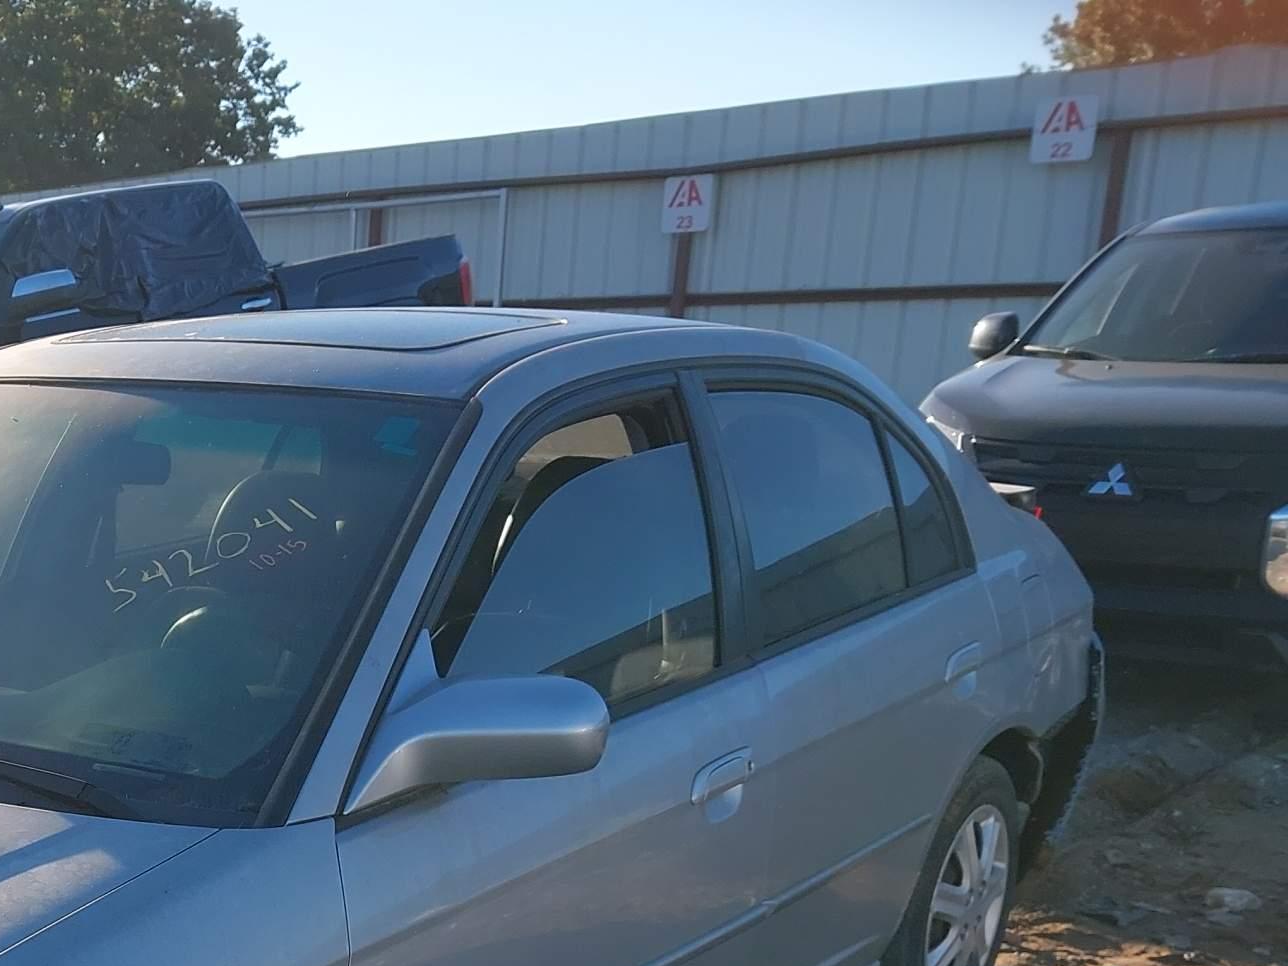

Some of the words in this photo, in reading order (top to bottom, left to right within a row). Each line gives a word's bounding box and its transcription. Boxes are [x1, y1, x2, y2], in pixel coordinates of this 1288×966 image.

[1050, 143, 1073, 159] 22
[676, 215, 693, 229] 23
[105, 498, 318, 613] 542041
[248, 539, 307, 571] 10-15
